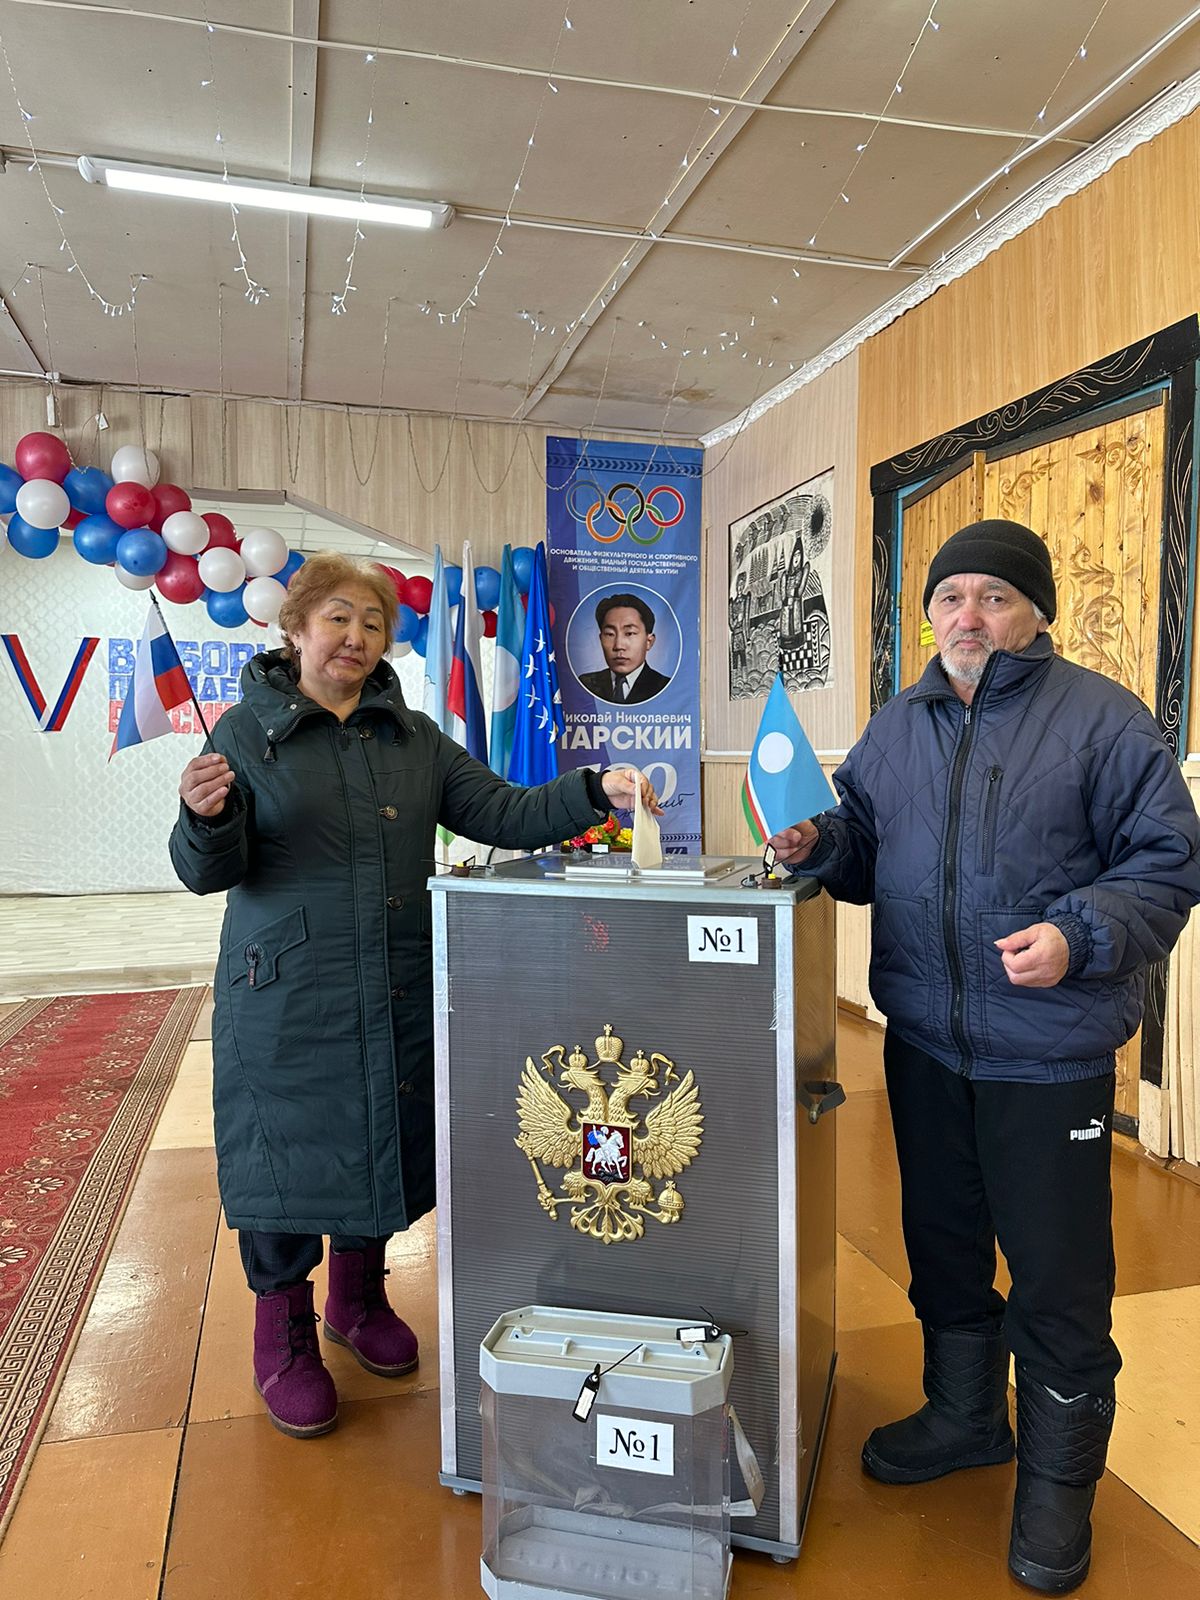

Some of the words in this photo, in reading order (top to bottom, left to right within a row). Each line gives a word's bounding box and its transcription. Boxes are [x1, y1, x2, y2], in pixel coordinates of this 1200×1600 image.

[550, 548, 592, 556] ОСНОВАТЕЛЬ
[593, 550, 648, 559] ФИЗКУЛЬТУРНОГО
[654, 553, 698, 561] СПОРТИВНОГО
[563, 556, 600, 564] ДВИЖЕНИЯ,
[601, 558, 627, 566] ВИДНЫЙ
[628, 560, 687, 568] ГОСУДАРСТВЕННЫЙ
[578, 565, 628, 573] ОБЩЕСТВЕННЫЙ
[563, 711, 612, 723] иколай
[616, 711, 691, 723] Николаевич
[1070, 1127, 1101, 1140] PUMA
